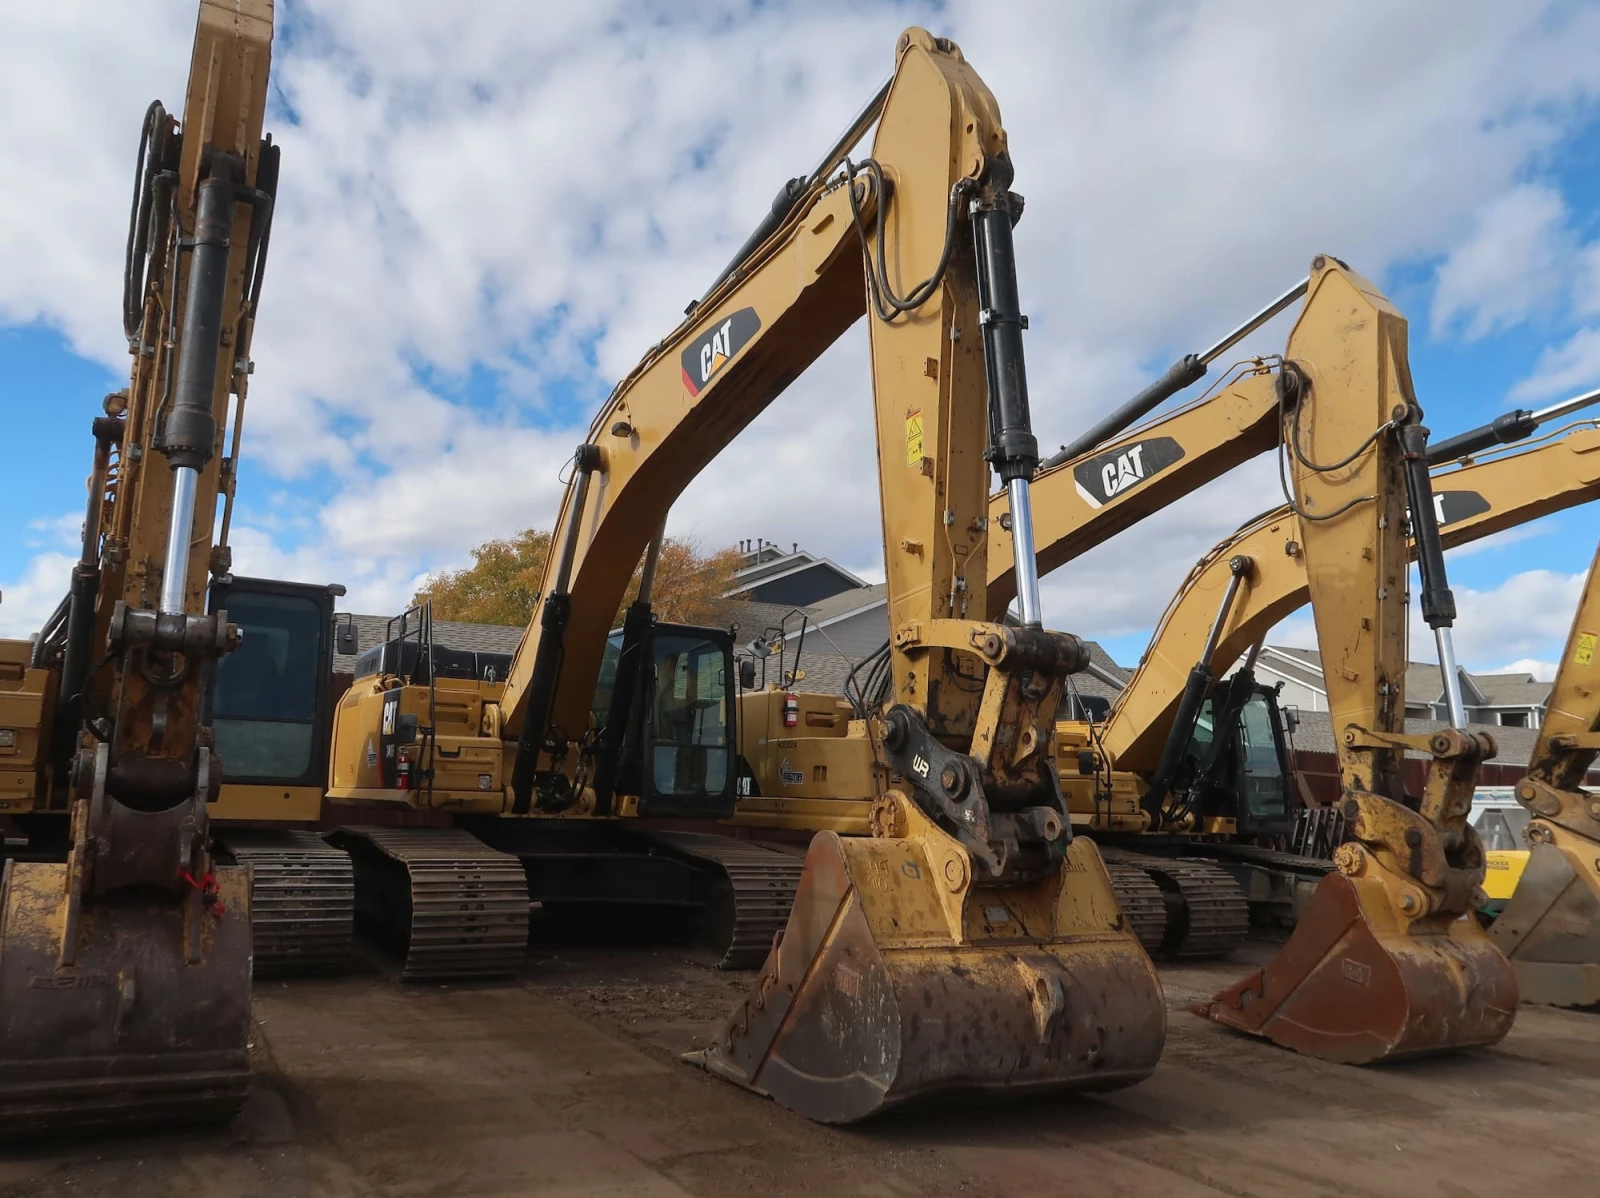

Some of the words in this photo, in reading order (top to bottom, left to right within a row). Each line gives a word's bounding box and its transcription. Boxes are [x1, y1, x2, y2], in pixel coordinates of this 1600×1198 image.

[700, 318, 732, 382] CAT
[1101, 444, 1144, 497] CAT
[736, 777, 751, 795] CAT
